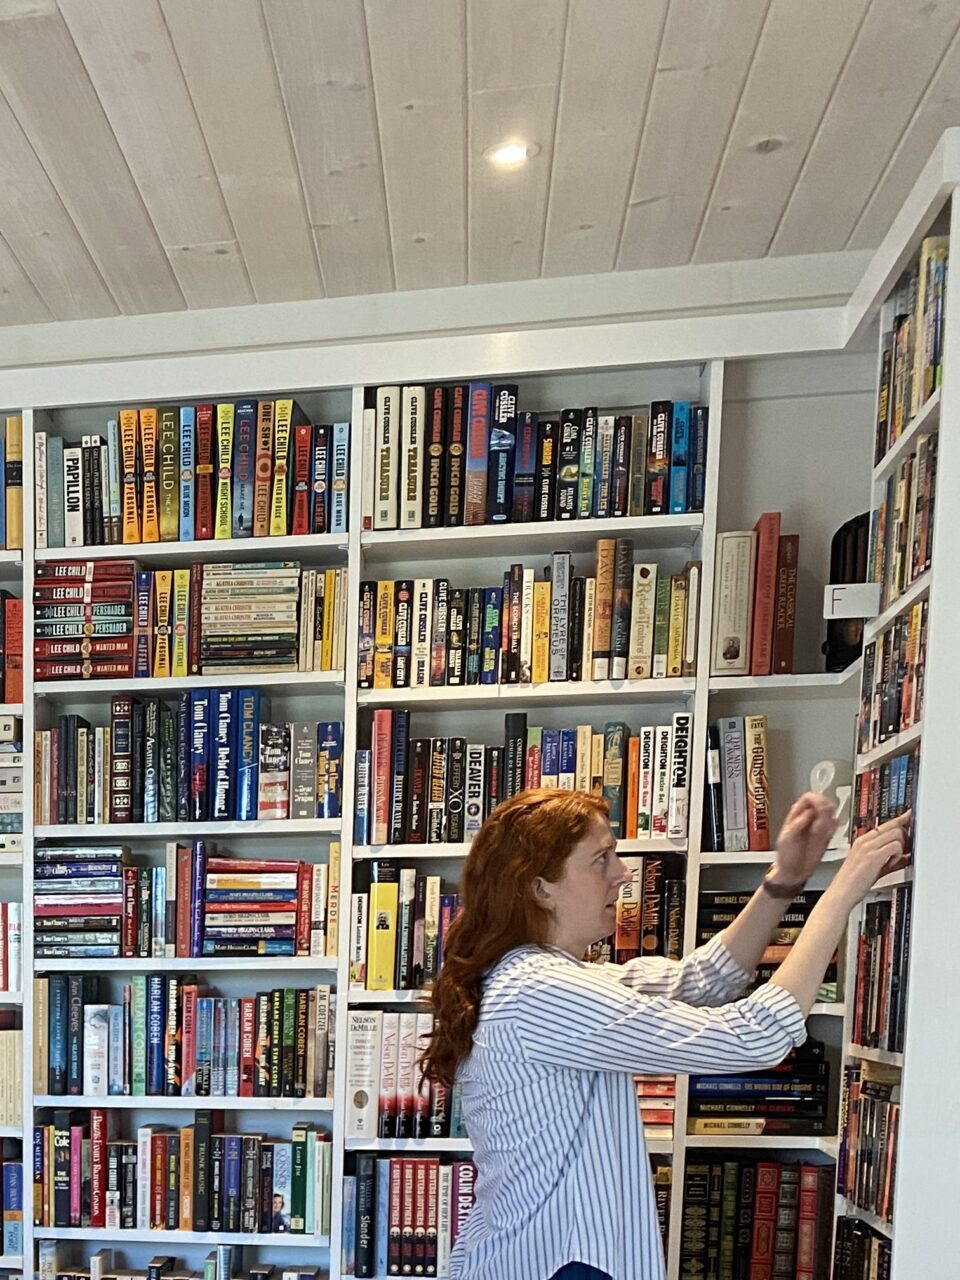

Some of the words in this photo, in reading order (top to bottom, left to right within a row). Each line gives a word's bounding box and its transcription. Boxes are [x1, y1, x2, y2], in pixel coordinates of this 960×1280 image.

[122, 425, 134, 443] LEE
[143, 424, 154, 442] LEE
[162, 412, 174, 441] LEE
[221, 421, 231, 439] LEE
[124, 444, 135, 474] CHILD
[143, 443, 155, 472] CHILD
[163, 443, 175, 490] CHILD
[221, 440, 231, 464] CHILD
[315, 446, 326, 458] LEE
[315, 459, 326, 481] CHILD
[65, 457, 80, 514] PAPILLON
[125, 486, 134, 525] PERSONAL
[146, 485, 155, 523] PERSONAL
[55, 566, 68, 577] LEE
[68, 566, 86, 577] CHILD
[598, 548, 614, 594] DAVIS
[54, 606, 67, 617] LEE
[66, 606, 85, 617] CHILD
[93, 605, 126, 616] PERSUADER
[139, 592, 148, 608] LEE
[52, 624, 65, 635] LEE
[65, 624, 83, 635] CHILD
[95, 624, 127, 634] PERSUADER
[139, 608, 148, 626] CHILD
[551, 599, 560, 657] ORPHEUS
[194, 699, 208, 722] Tom
[218, 691, 232, 713] Tom
[243, 695, 255, 719] TOM
[191, 723, 207, 756] Clancy
[214, 713, 231, 745] Clancy
[242, 721, 254, 765] CLANCY
[218, 747, 231, 773] Debt
[673, 716, 690, 788] DEIGHTON
[468, 751, 484, 800] DEAVER
[215, 784, 230, 811] Honor
[753, 785, 767, 830] GOTHAM
[643, 860, 662, 893] Nelson
[329, 885, 338, 924] MERDE
[642, 893, 661, 938] DeMille
[71, 978, 80, 997] Ann
[133, 978, 145, 1025] HARLAN
[148, 976, 162, 1011] HARLAN
[70, 998, 82, 1033] Cleeves
[243, 1002, 254, 1030] HARLAN
[299, 992, 309, 1021] HARLAN
[352, 1016, 377, 1024] NELSON
[149, 1012, 161, 1044] COBEN
[297, 1023, 307, 1056] COBEN
[133, 1027, 145, 1071] COBEN
[242, 1032, 252, 1058] COBEN
[277, 1148, 289, 1190] CONNOR
[360, 1215, 370, 1249] Slander
